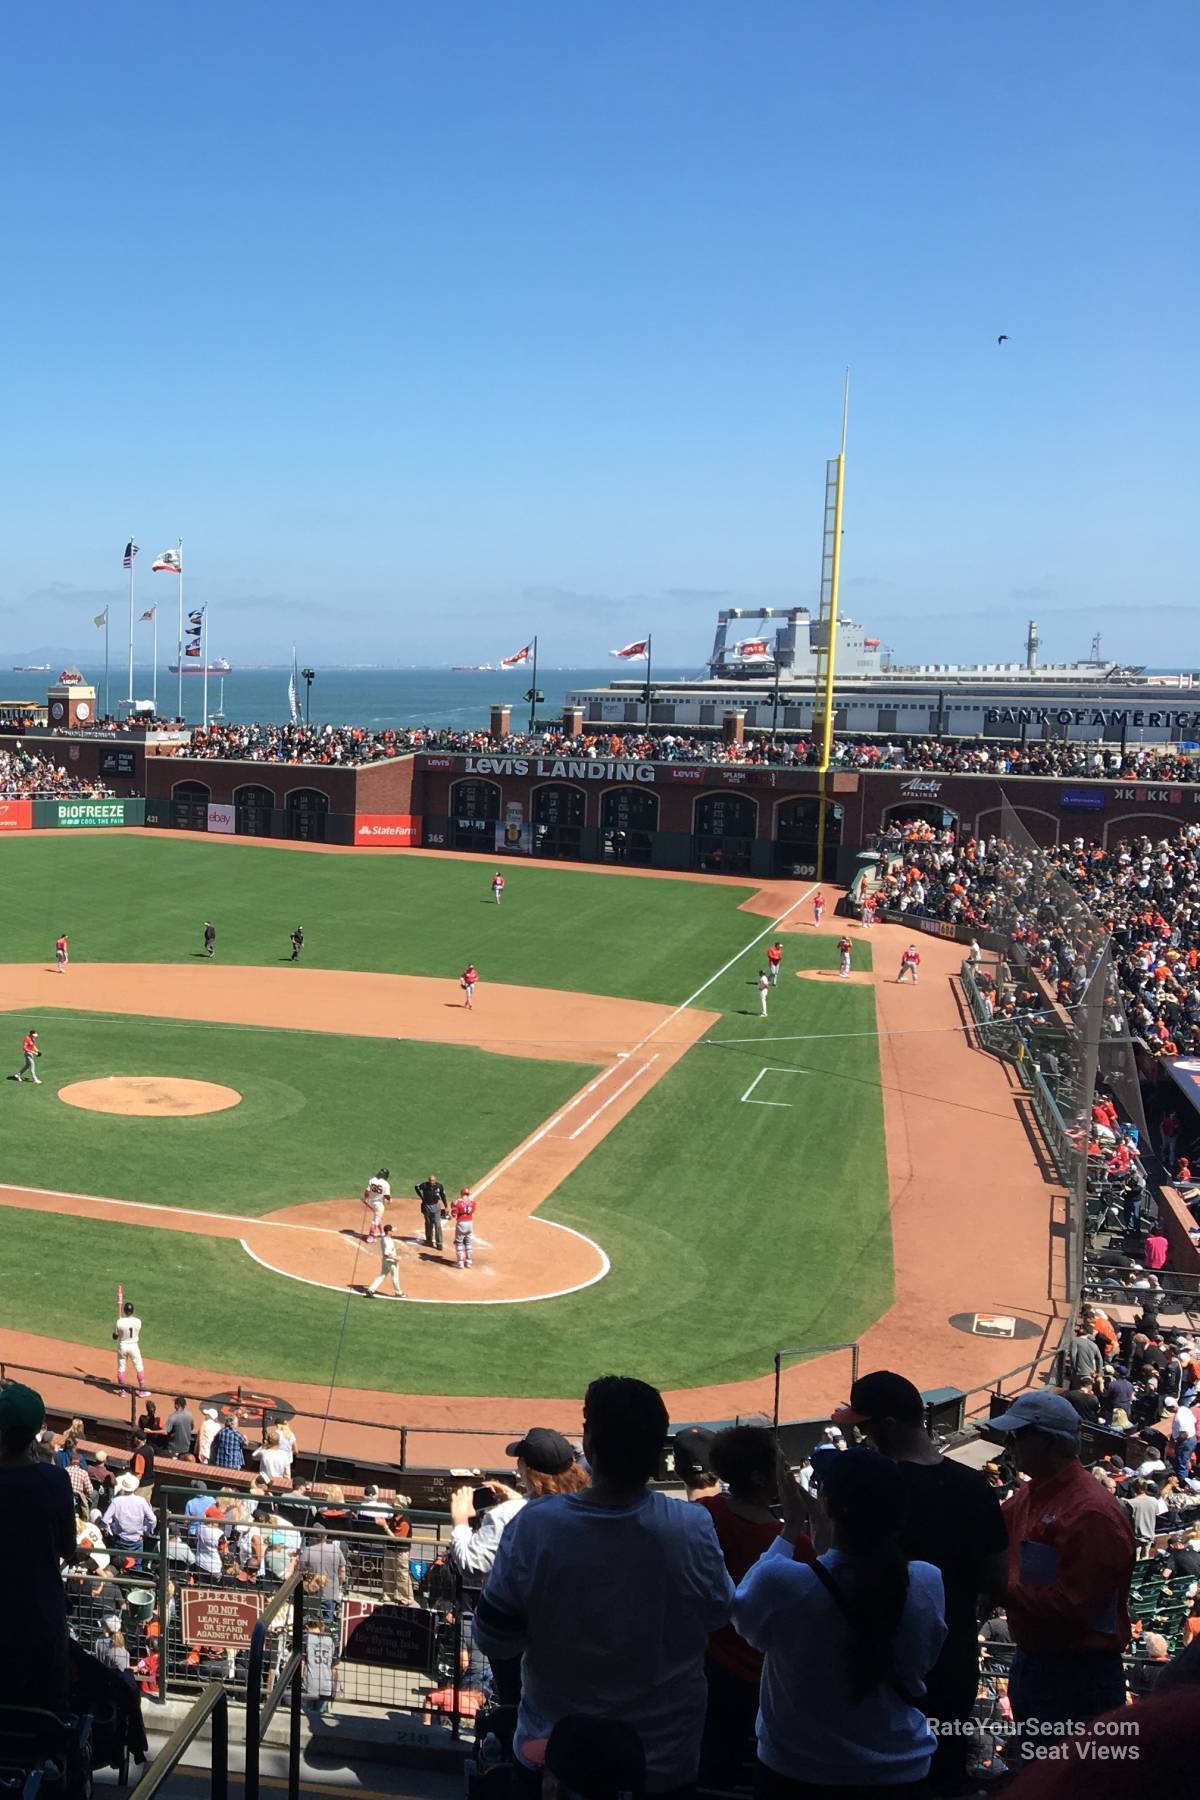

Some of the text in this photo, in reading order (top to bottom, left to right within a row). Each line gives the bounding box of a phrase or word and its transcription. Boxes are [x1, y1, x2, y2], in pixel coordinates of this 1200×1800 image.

[987, 709, 1049, 725] BANK
[1057, 710, 1086, 725] OF
[537, 761, 655, 782] LANDING
[900, 778, 942, 792] Alaska
[209, 812, 230, 824] ebay
[428, 834, 444, 843] 365
[793, 865, 815, 876] 309
[129, 1327, 133, 1338] 1
[198, 1592, 247, 1604] PLEASE
[208, 1605, 238, 1615] DO NOT
[216, 1625, 243, 1633] STAND
[197, 1631, 231, 1639] AGAINST
